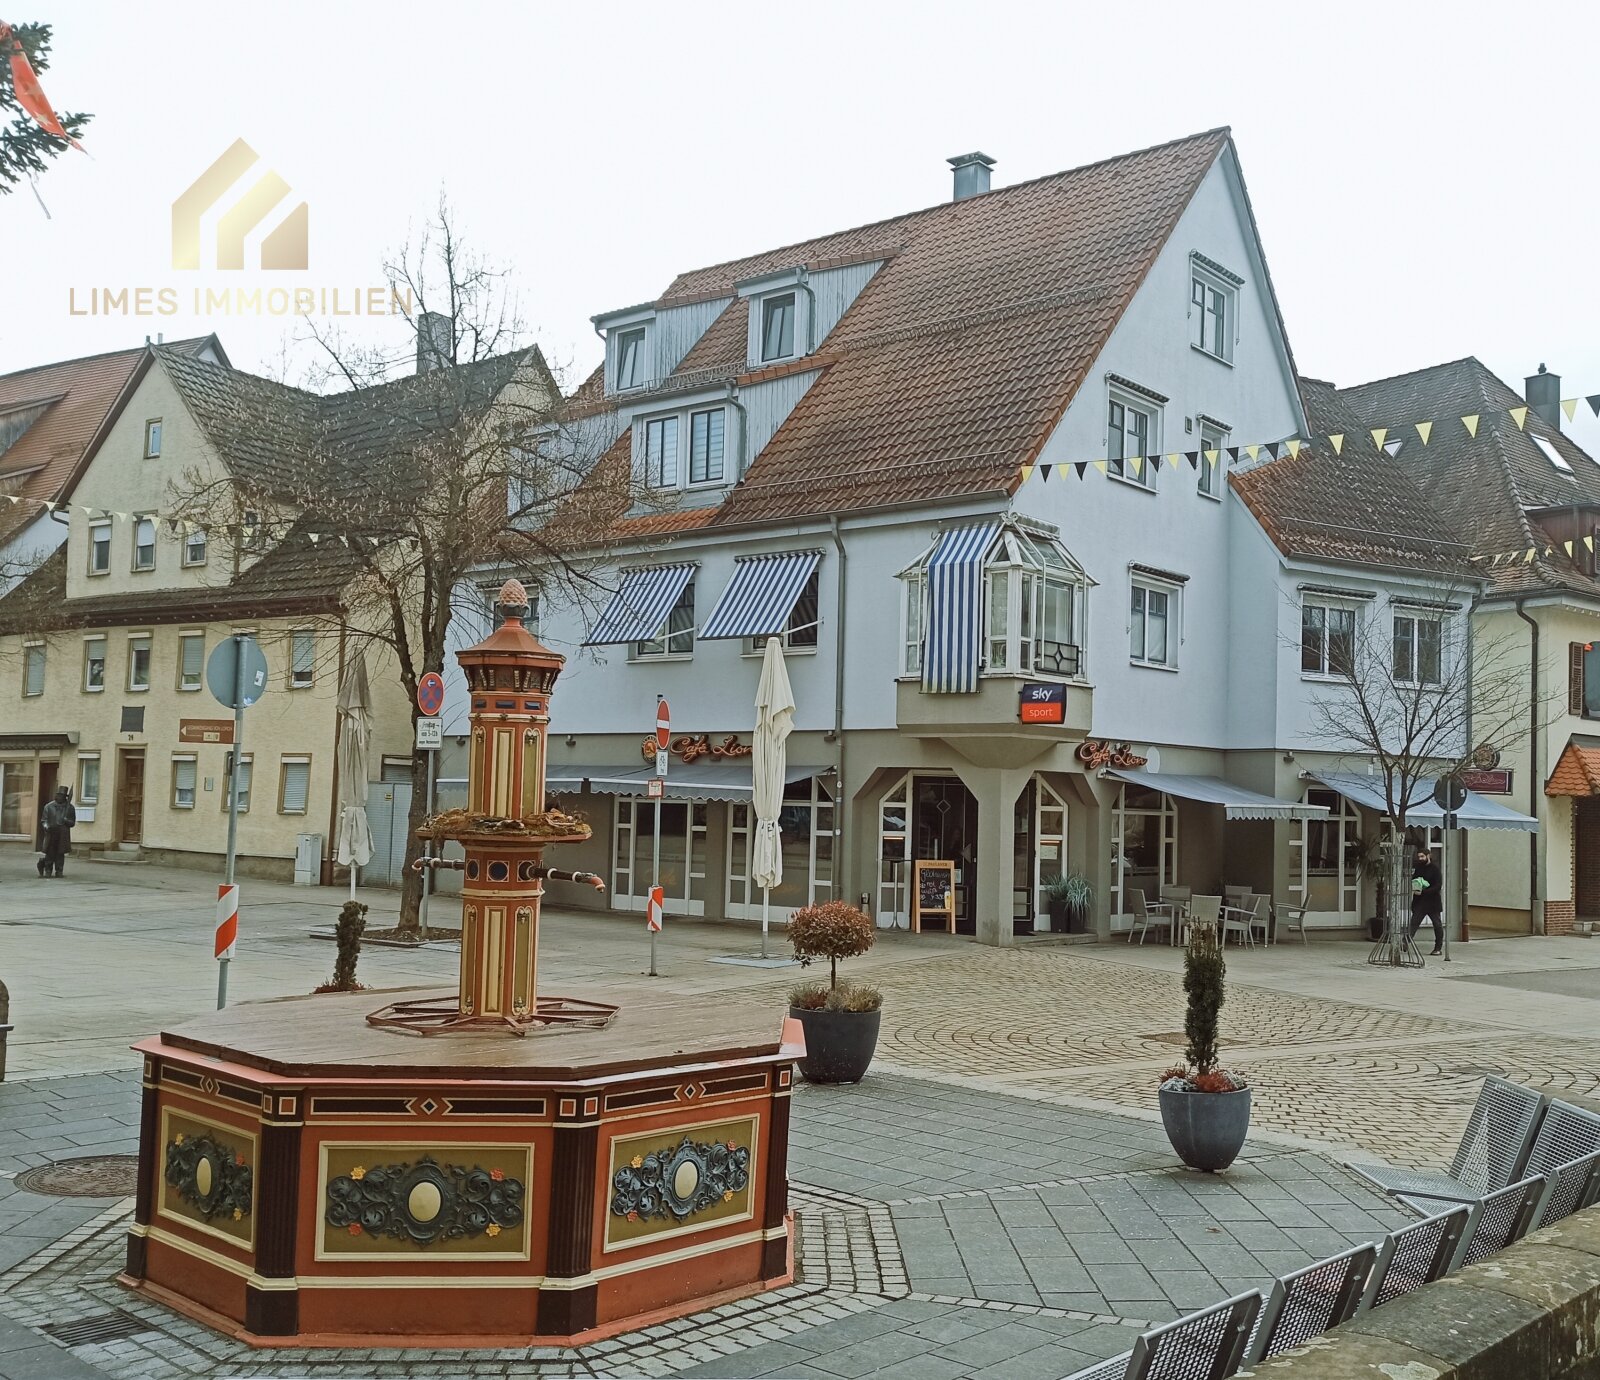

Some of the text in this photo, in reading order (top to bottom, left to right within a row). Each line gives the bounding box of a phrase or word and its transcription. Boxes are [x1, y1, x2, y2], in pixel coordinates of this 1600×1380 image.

[1032, 687, 1053, 702] sky
[1029, 708, 1053, 718] sport
[670, 735, 709, 762] Café
[712, 735, 753, 756] Lion
[1077, 741, 1148, 769] Café Lion
